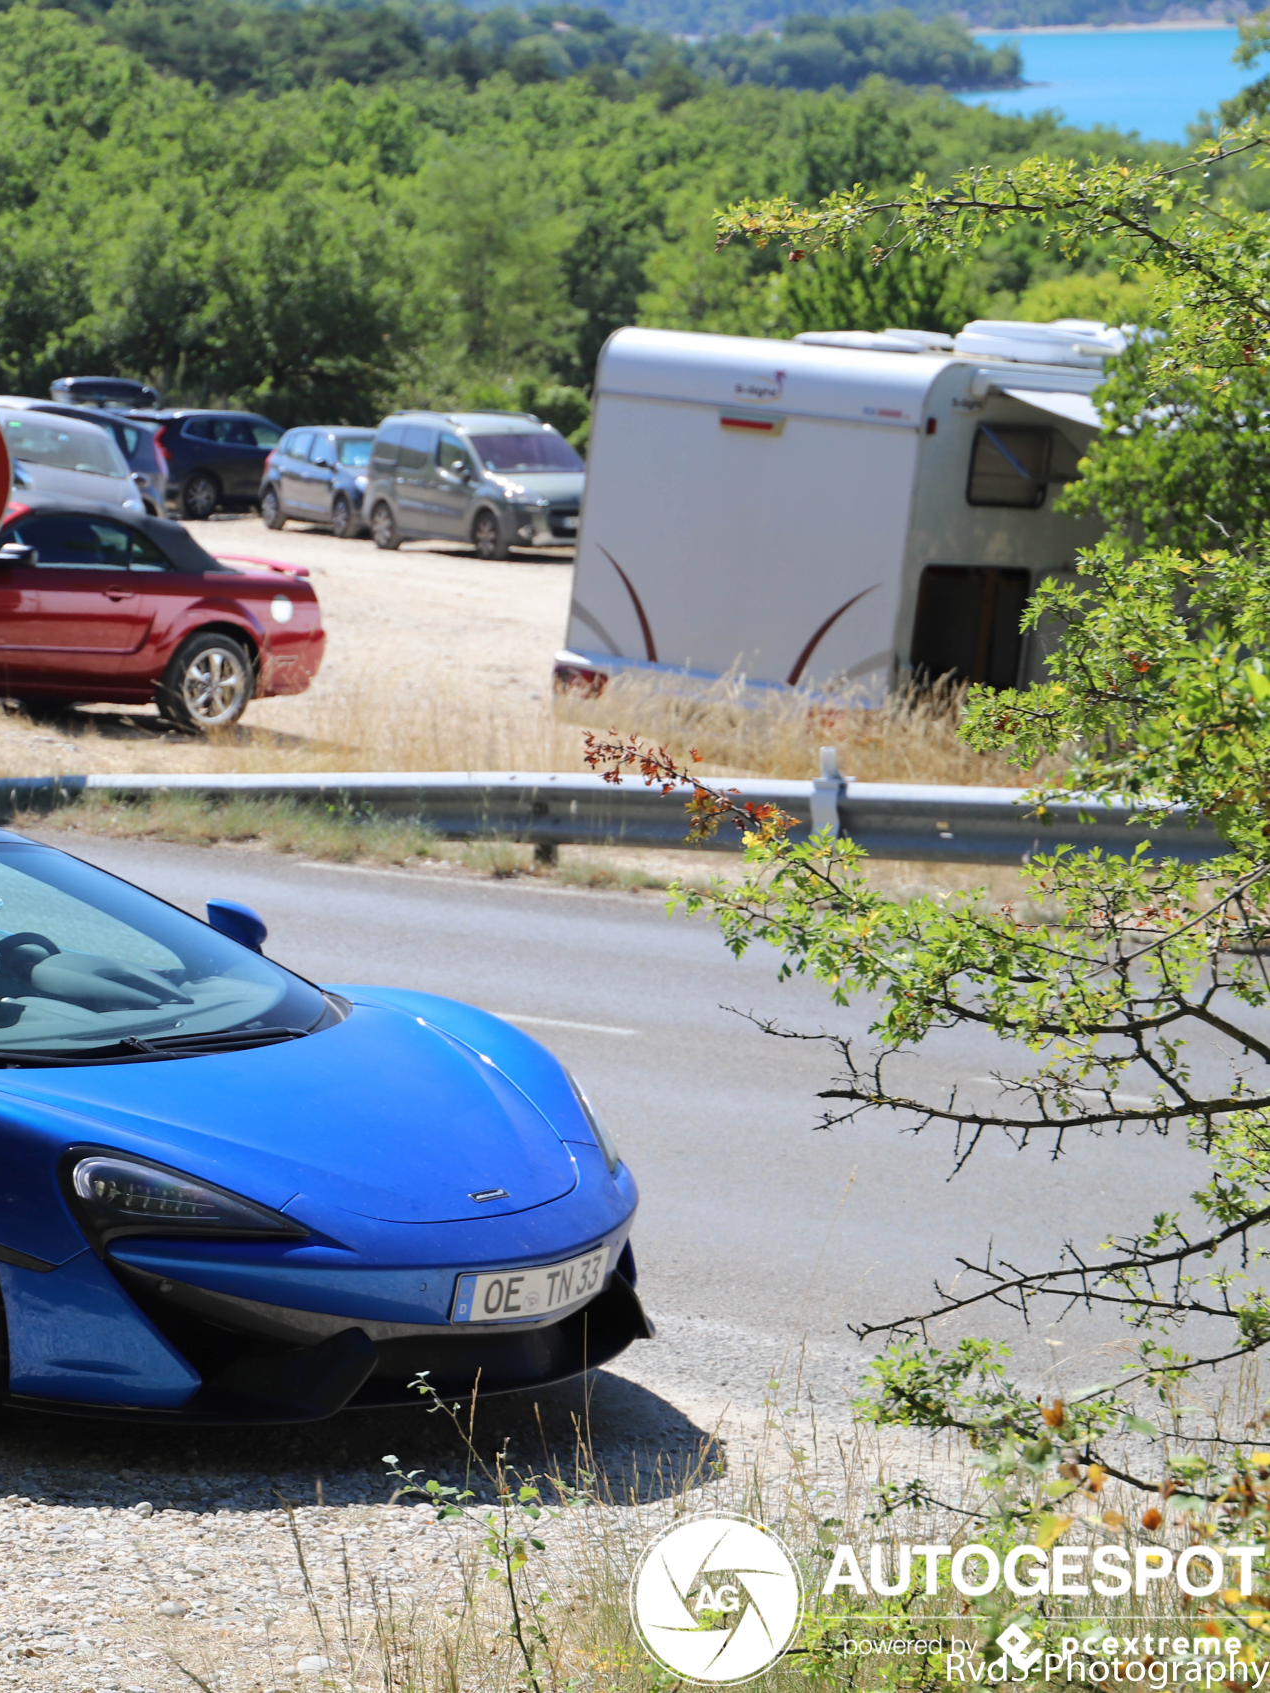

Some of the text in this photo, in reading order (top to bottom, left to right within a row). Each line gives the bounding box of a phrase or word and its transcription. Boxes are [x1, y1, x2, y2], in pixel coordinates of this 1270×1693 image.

[484, 1255, 602, 1314] OE TN 33
[459, 1303, 467, 1314] D
